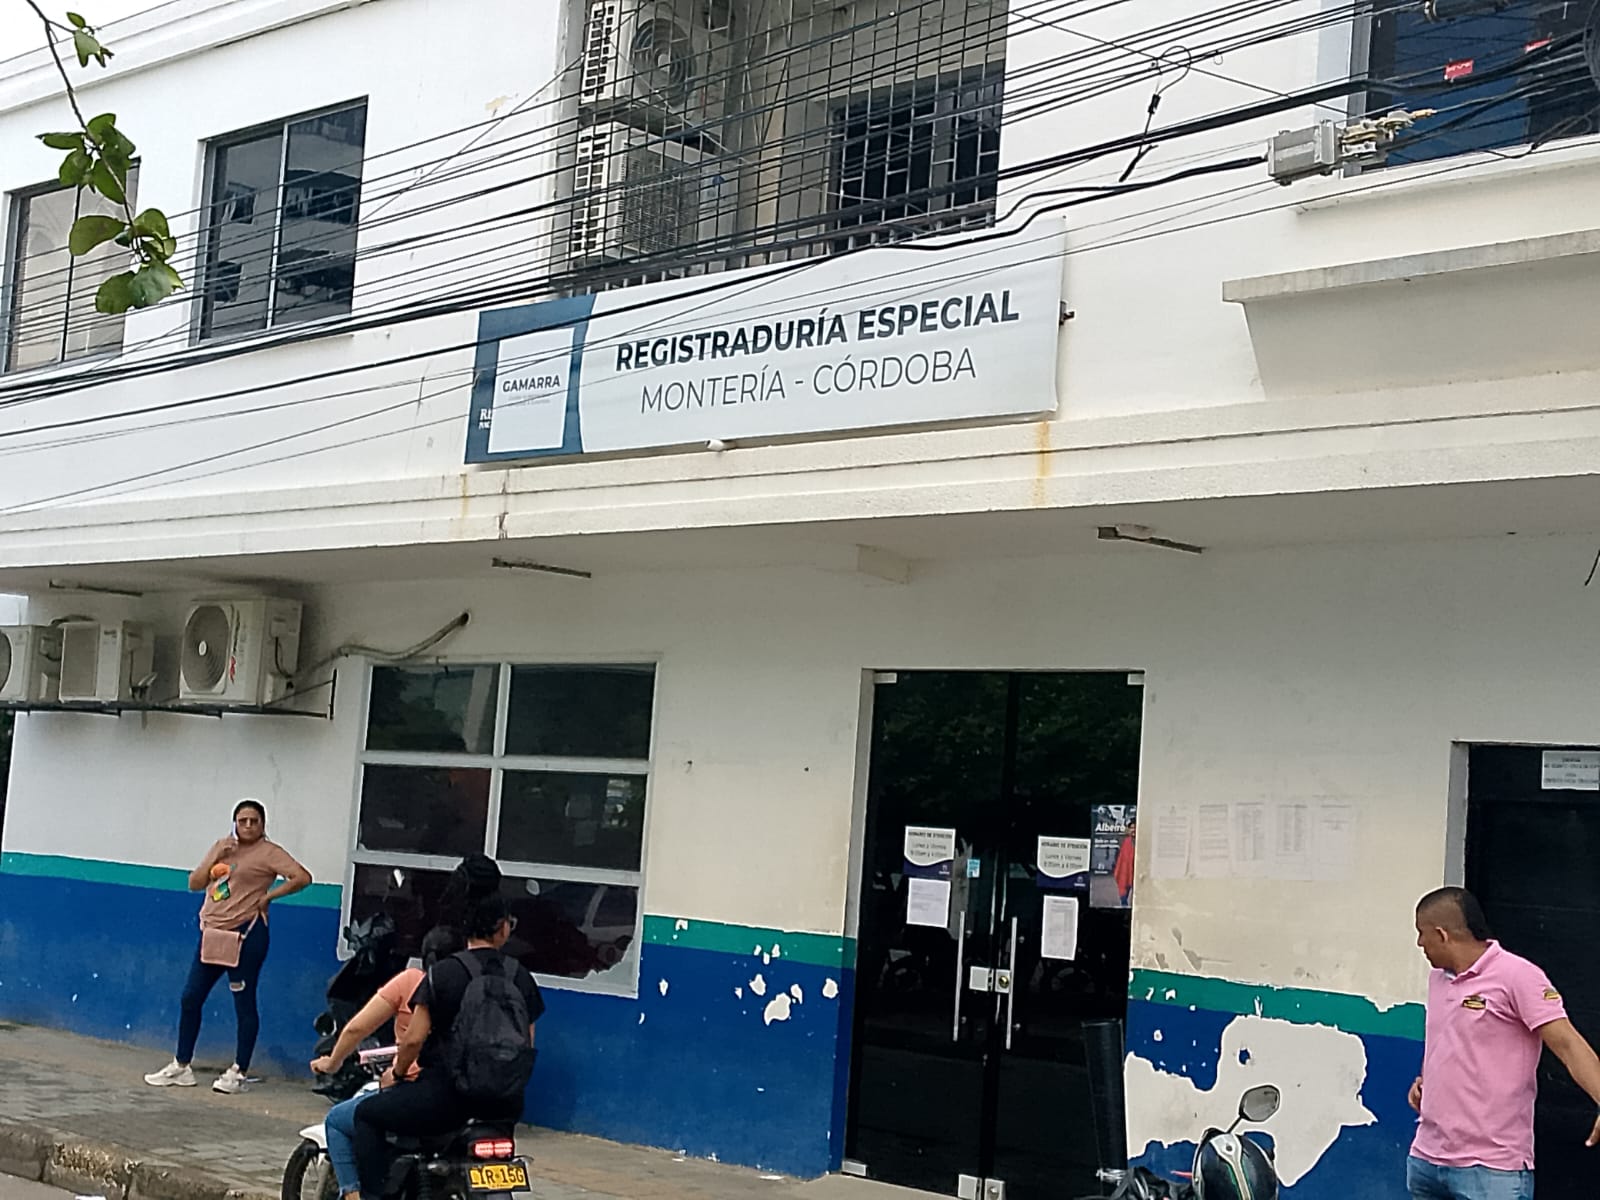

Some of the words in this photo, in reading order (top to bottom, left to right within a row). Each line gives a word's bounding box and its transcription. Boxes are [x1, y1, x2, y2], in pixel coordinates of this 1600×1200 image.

[616, 308, 848, 371] REGISTRADURÍA
[857, 290, 1019, 340] ESPECIAL
[502, 375, 561, 393] GAMARRA
[641, 364, 786, 414] MONTERÍA
[813, 348, 976, 395] CÓRDOBA
